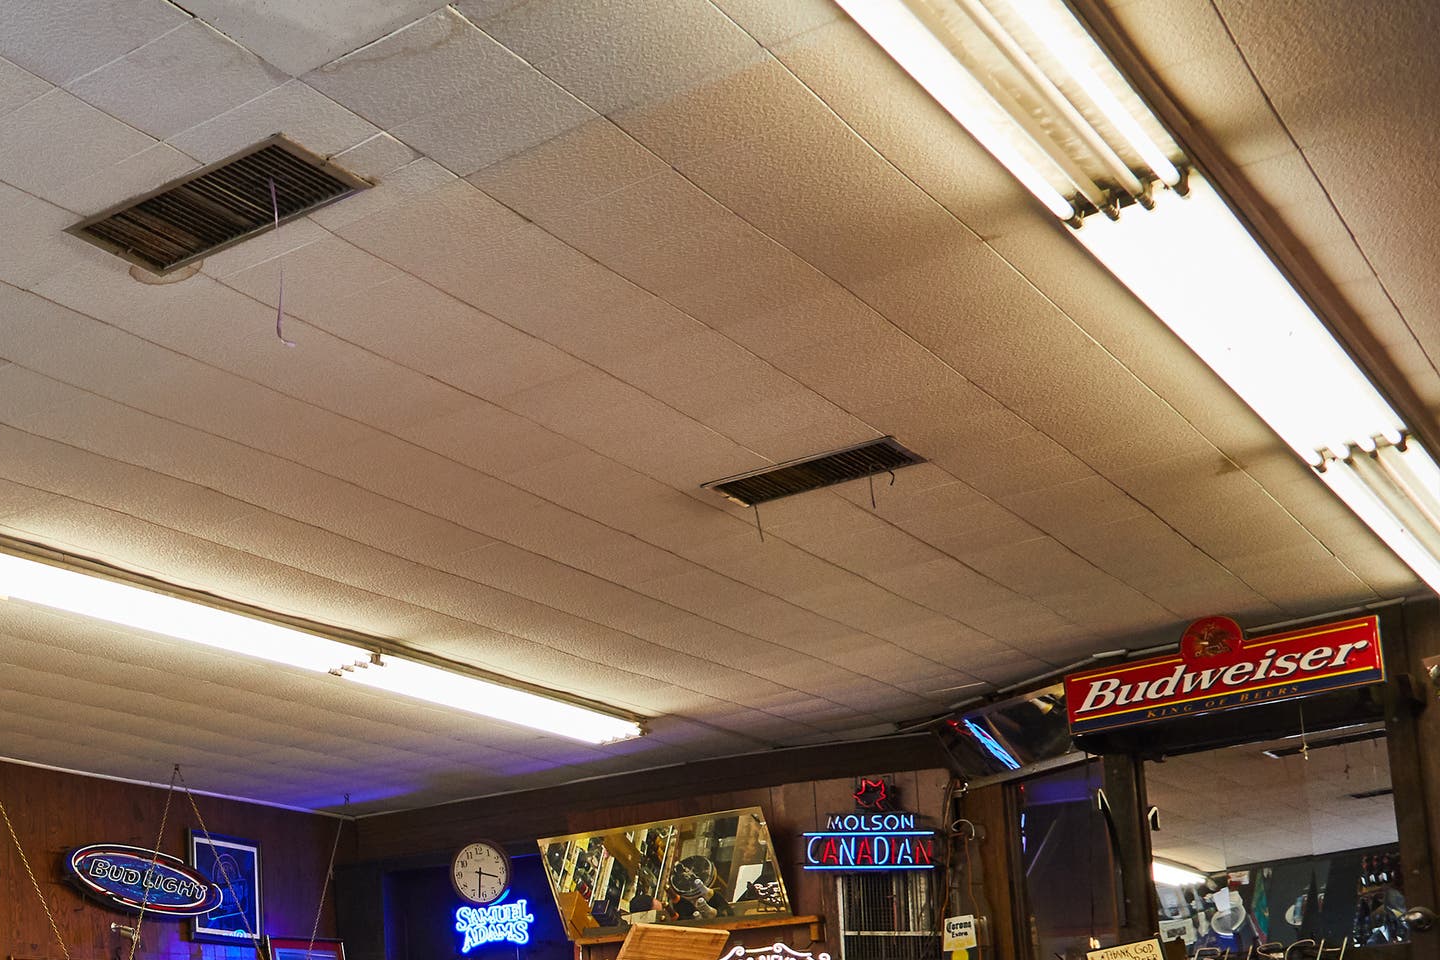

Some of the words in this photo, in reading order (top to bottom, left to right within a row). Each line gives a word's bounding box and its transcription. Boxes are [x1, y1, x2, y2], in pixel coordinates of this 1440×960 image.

[1076, 639, 1368, 715] Budweiser
[1147, 703, 1196, 719] KING
[1205, 699, 1227, 709] OF
[1240, 685, 1300, 702] BEERS
[826, 814, 914, 831] MOLSON
[807, 836, 932, 865] CANADIAN
[89, 859, 141, 885] BUD
[143, 871, 208, 899] LIGHT
[456, 899, 534, 932] SAMUEL
[946, 919, 973, 934] Corona
[462, 921, 529, 952] ADAMS
[951, 930, 968, 939] Extra
[1104, 948, 1132, 960] THANK
[1134, 943, 1154, 955] GOD
